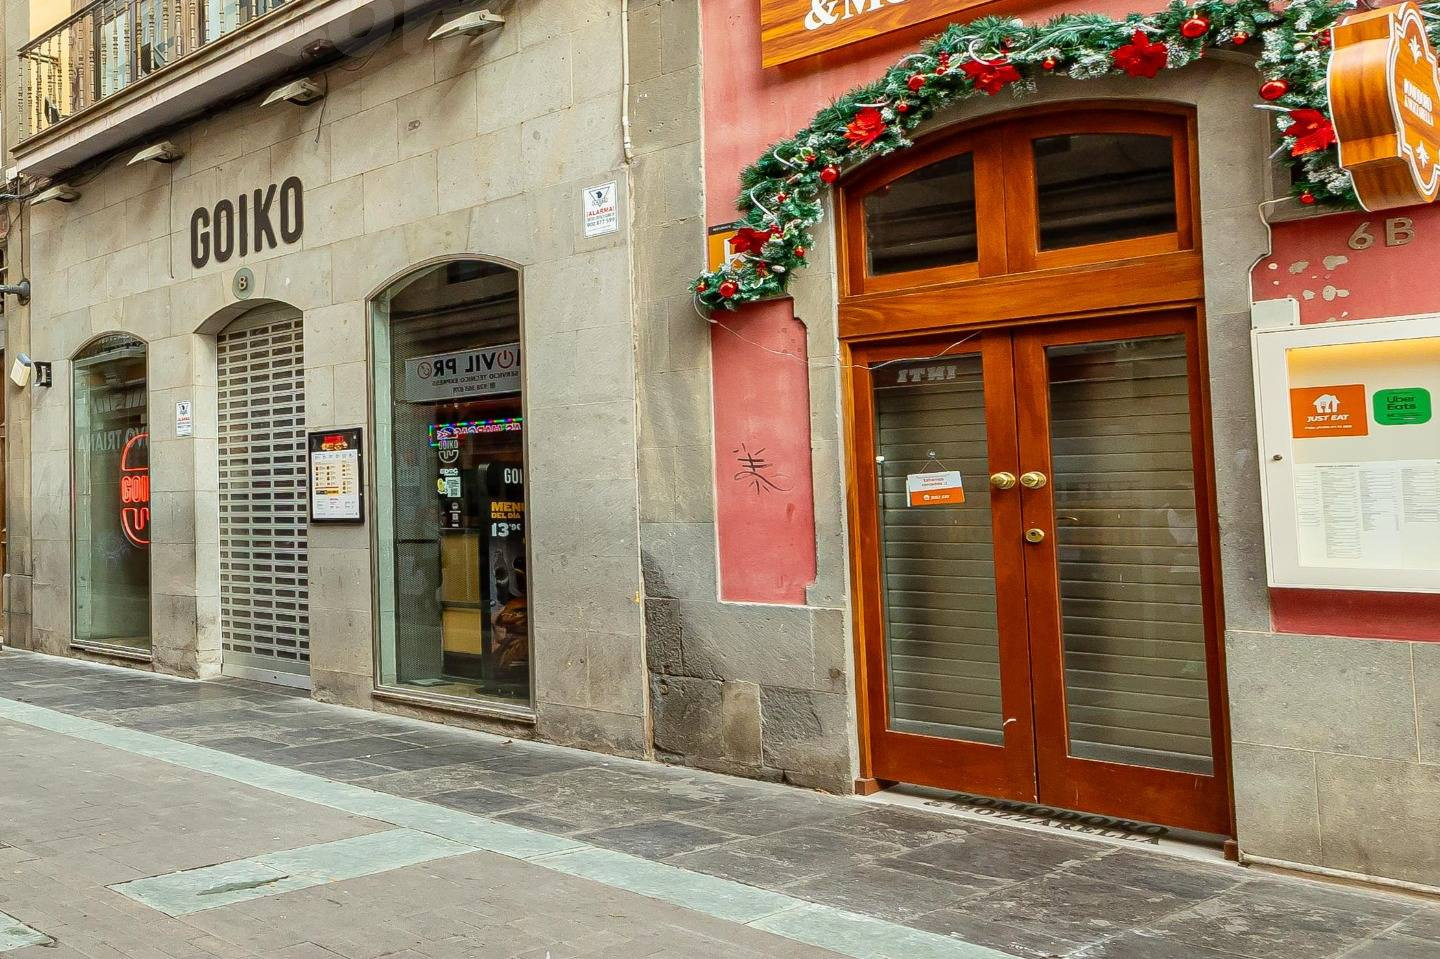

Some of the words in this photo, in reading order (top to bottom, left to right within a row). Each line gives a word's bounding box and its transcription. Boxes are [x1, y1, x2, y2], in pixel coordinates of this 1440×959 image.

[190, 176, 304, 269] GOIKO
[238, 276, 248, 291] 8
[1387, 395, 1416, 403] Uber
[1387, 403, 1416, 411] Eats
[948, 794, 1170, 836] POMODORO
